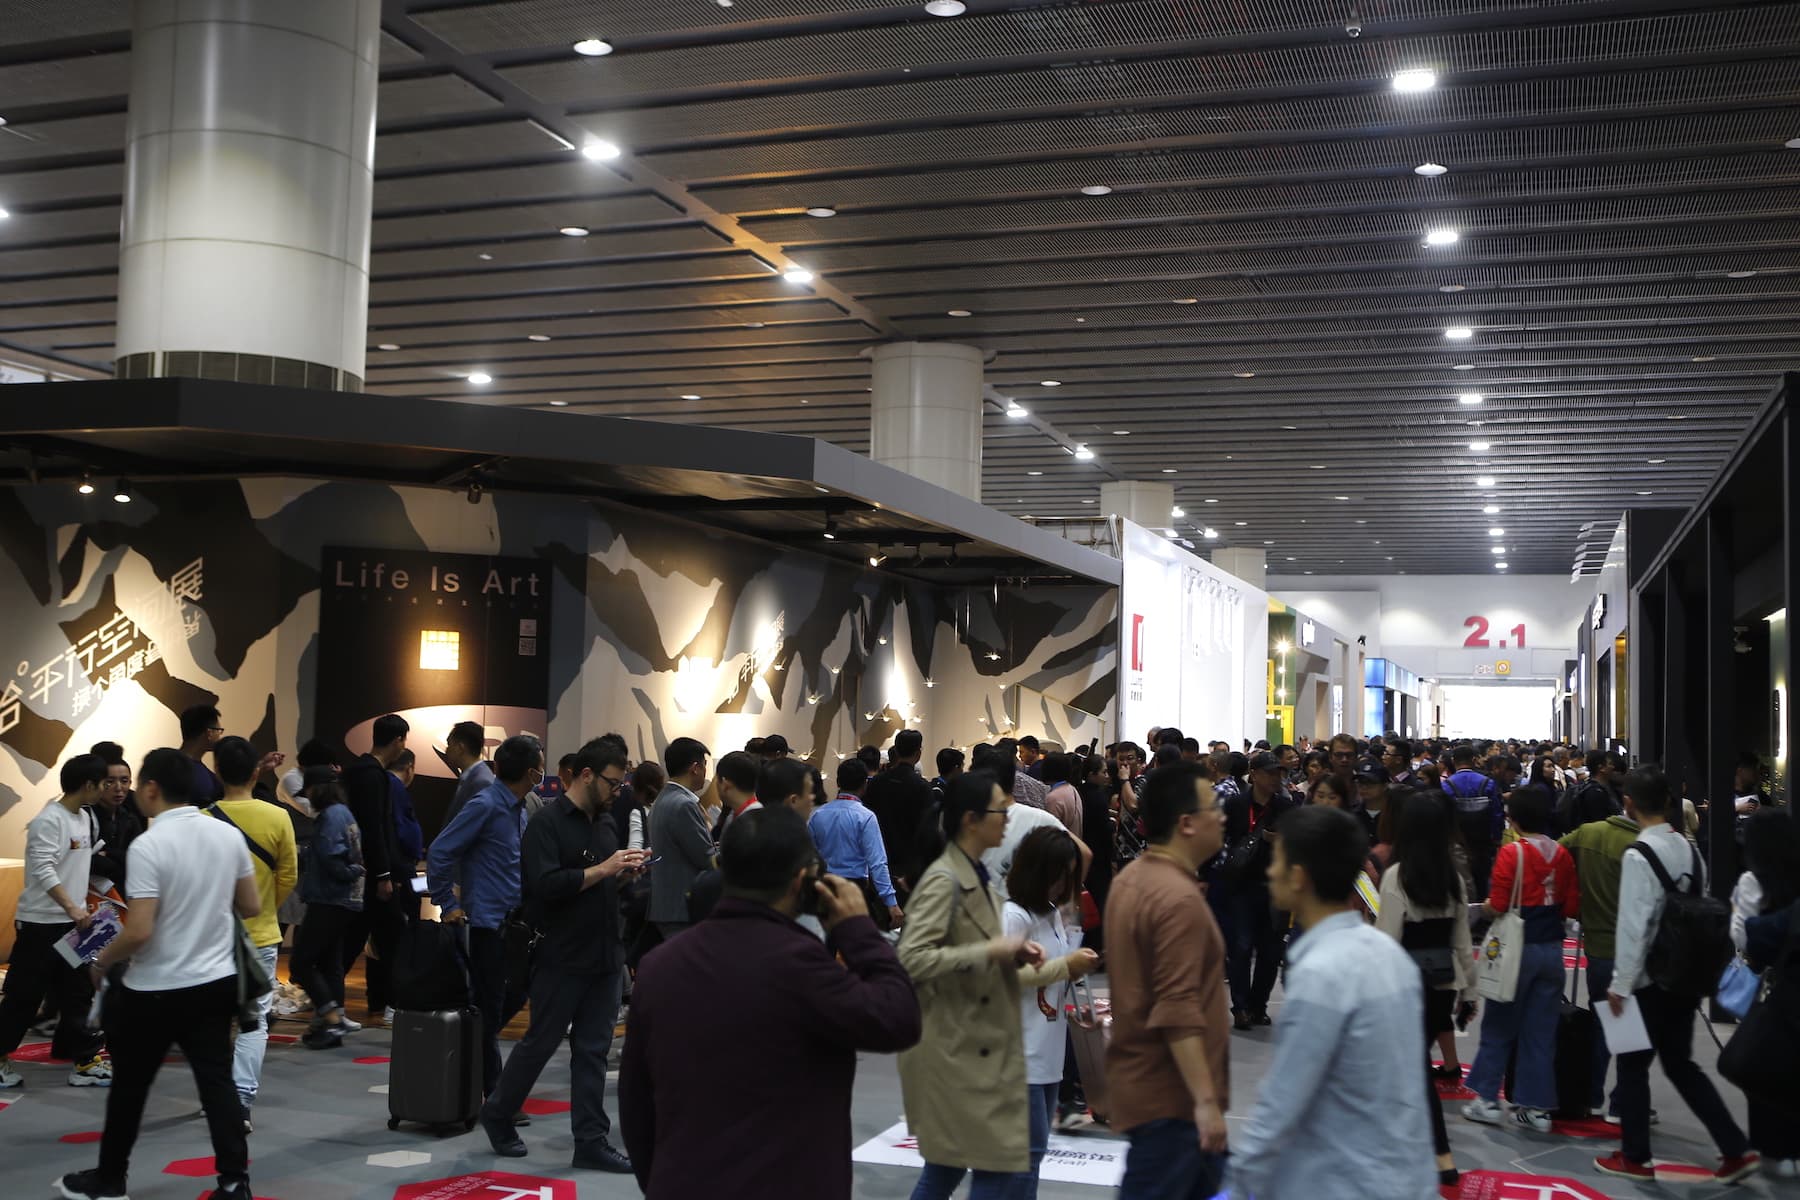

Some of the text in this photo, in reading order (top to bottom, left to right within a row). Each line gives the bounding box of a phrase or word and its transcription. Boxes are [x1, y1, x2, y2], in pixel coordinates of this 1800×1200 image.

[335, 560, 540, 597] Life Is Art
[1463, 615, 1526, 649] 2.1
